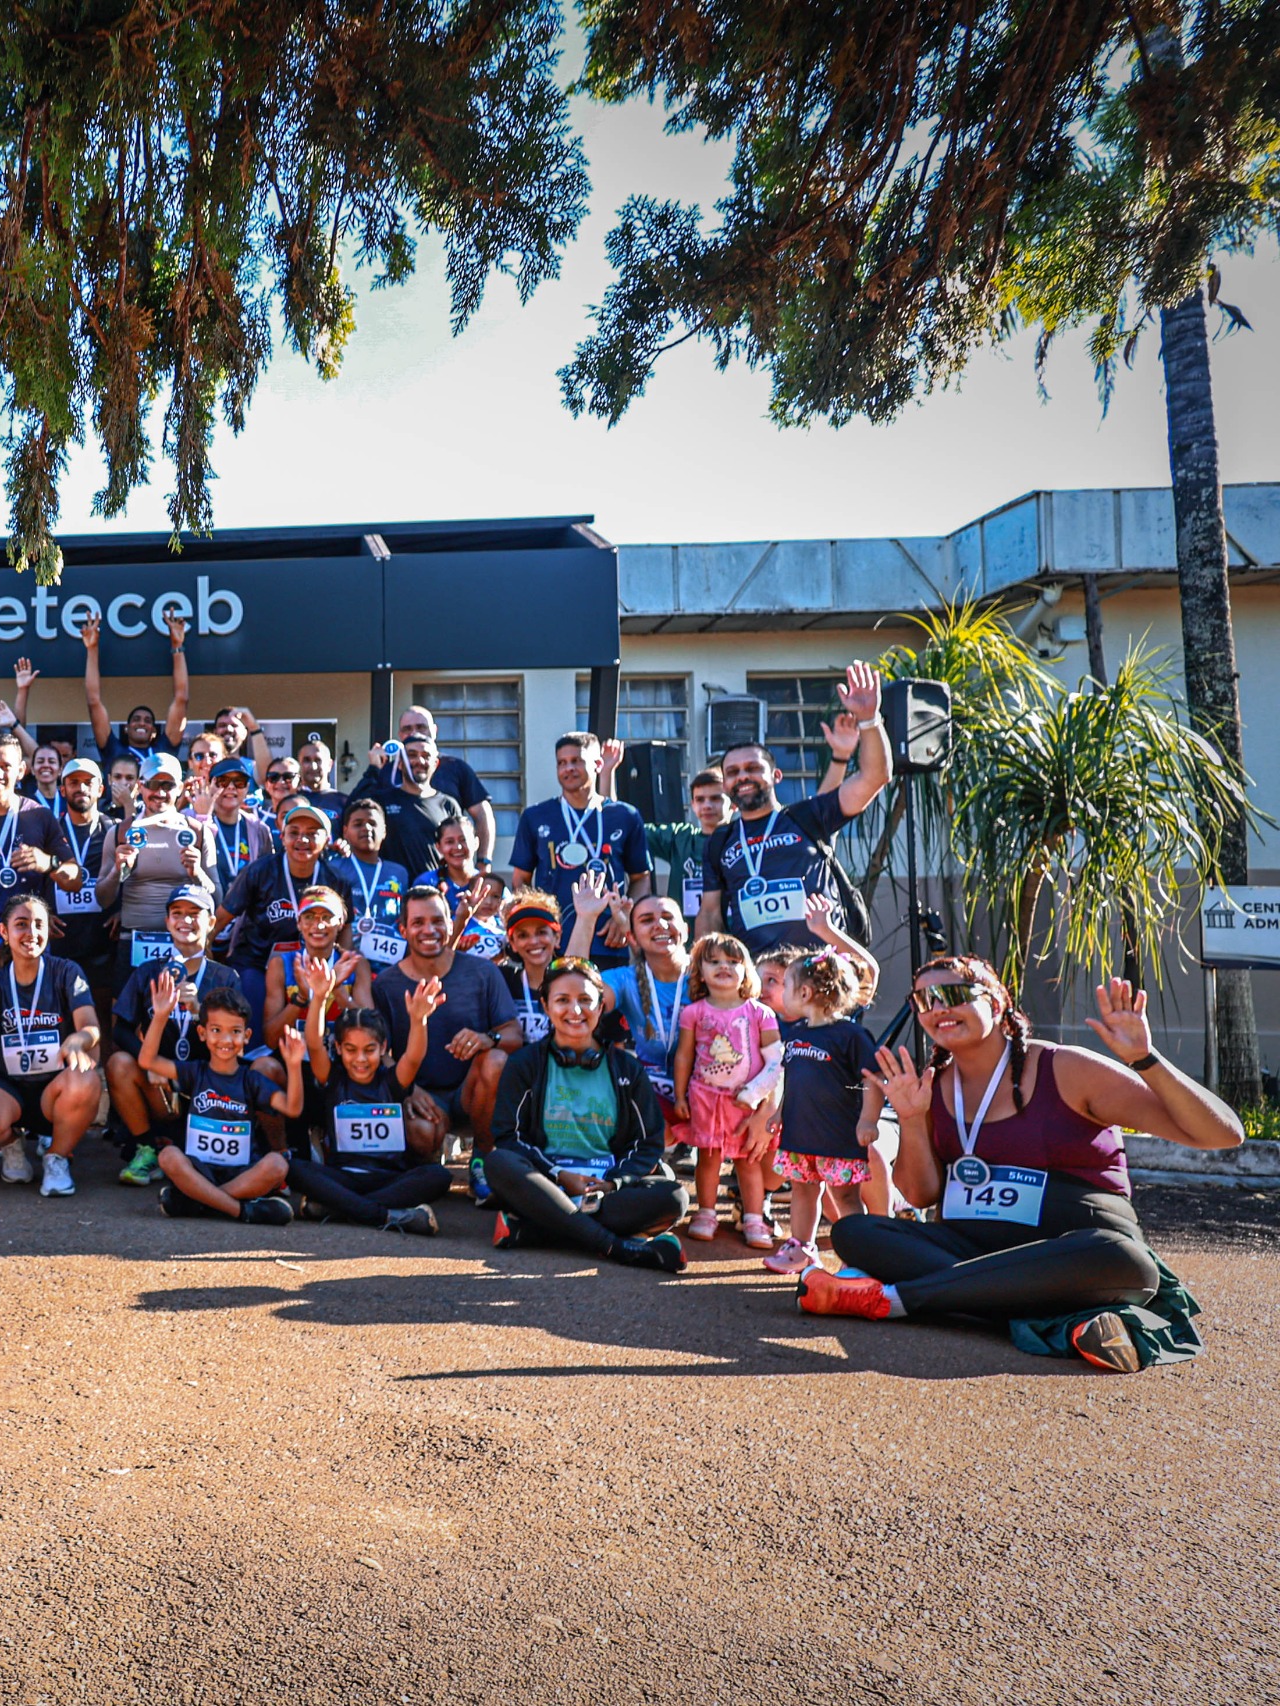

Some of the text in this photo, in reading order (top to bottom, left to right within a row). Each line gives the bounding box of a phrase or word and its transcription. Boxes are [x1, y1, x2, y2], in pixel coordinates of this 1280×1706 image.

[65, 891, 92, 904] 188
[754, 896, 790, 915] 101
[1243, 918, 1279, 929] ADM
[143, 946, 172, 959] 144
[372, 938, 398, 955] 146
[39, 1035, 55, 1043] 5km
[350, 1122, 390, 1140] 510
[197, 1134, 239, 1156] 508
[590, 1158, 609, 1167] 5km
[1008, 1171, 1037, 1183] 5km
[964, 1186, 1019, 1207] 149
